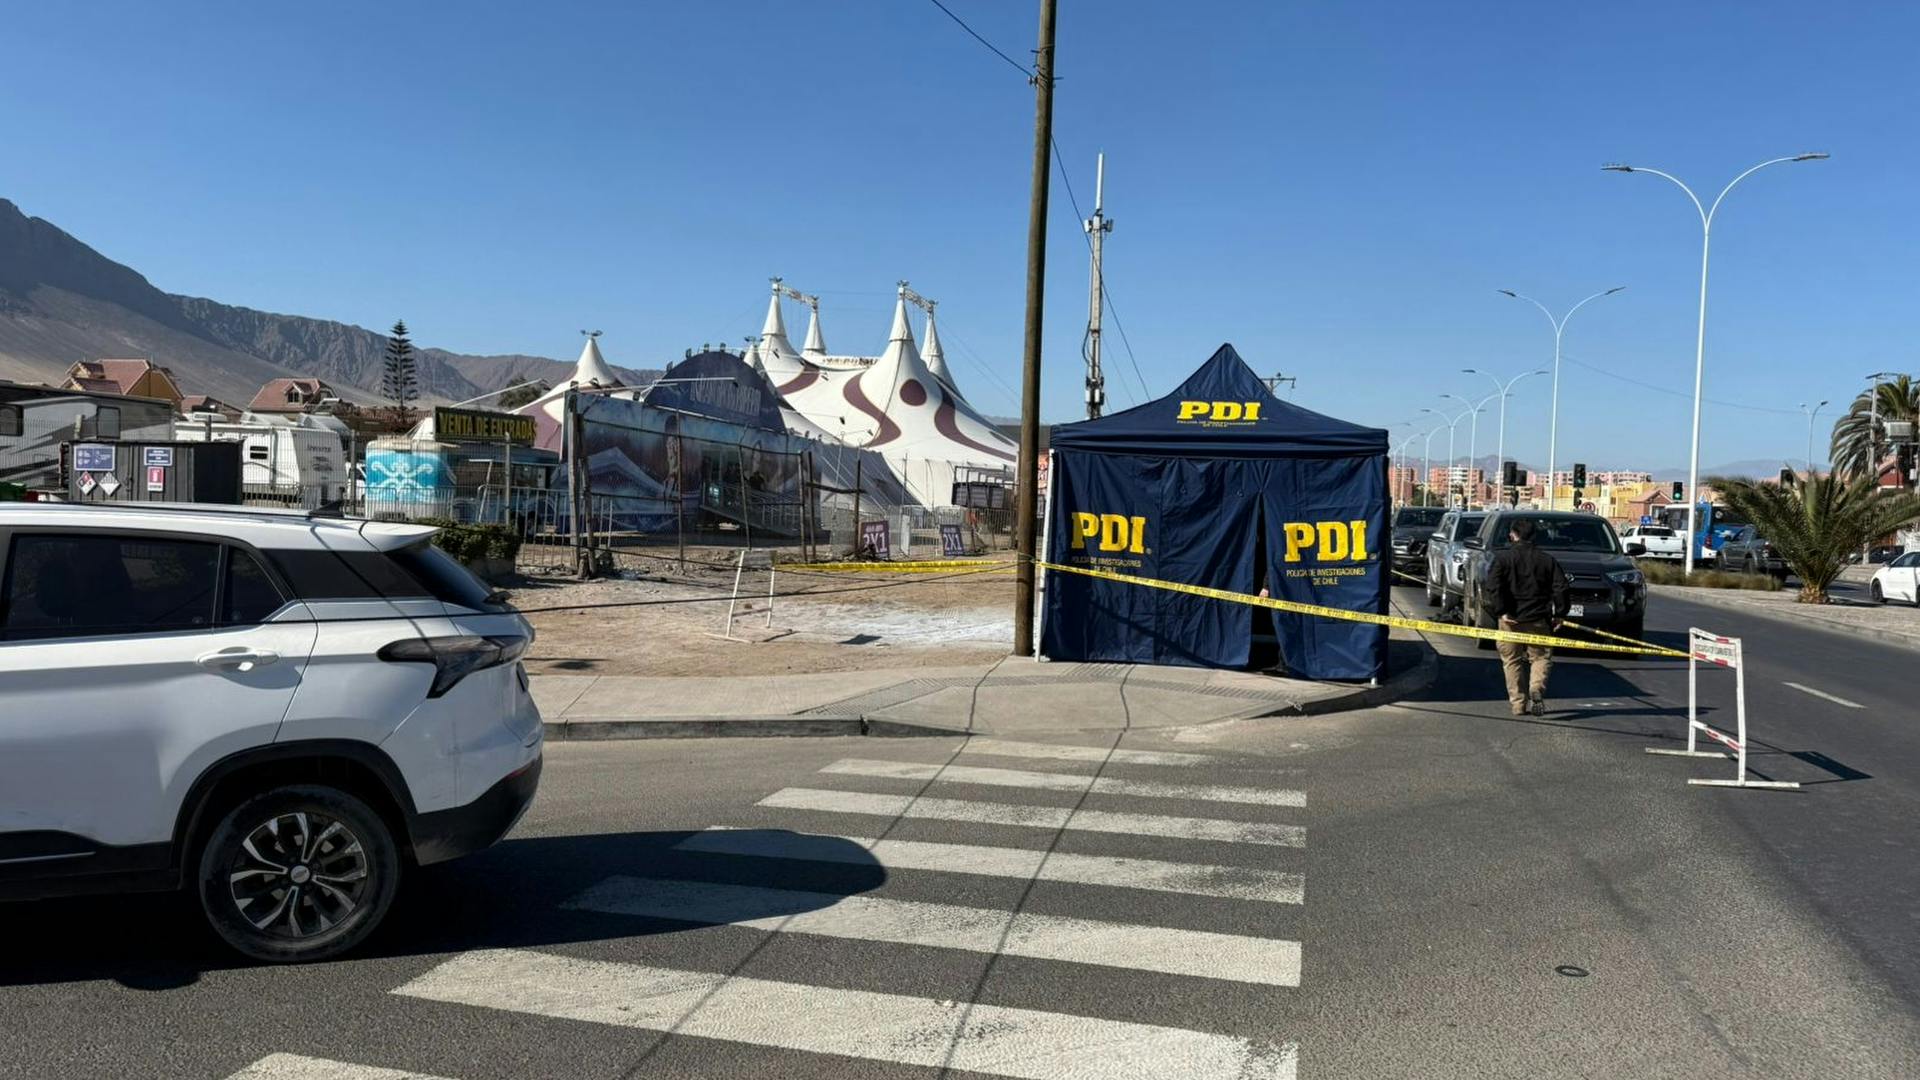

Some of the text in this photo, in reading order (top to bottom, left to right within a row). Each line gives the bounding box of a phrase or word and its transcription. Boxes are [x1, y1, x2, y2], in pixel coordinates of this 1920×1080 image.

[1176, 400, 1261, 421] PDI
[439, 411, 537, 440] VENTA DE ENTRADAS
[943, 533, 962, 551] 2X1
[1071, 512, 1146, 554] PDI
[1283, 520, 1367, 562] PDI
[1312, 577, 1339, 586] DE CHILE
[1317, 567, 1366, 577] INVESTIGACIONES
